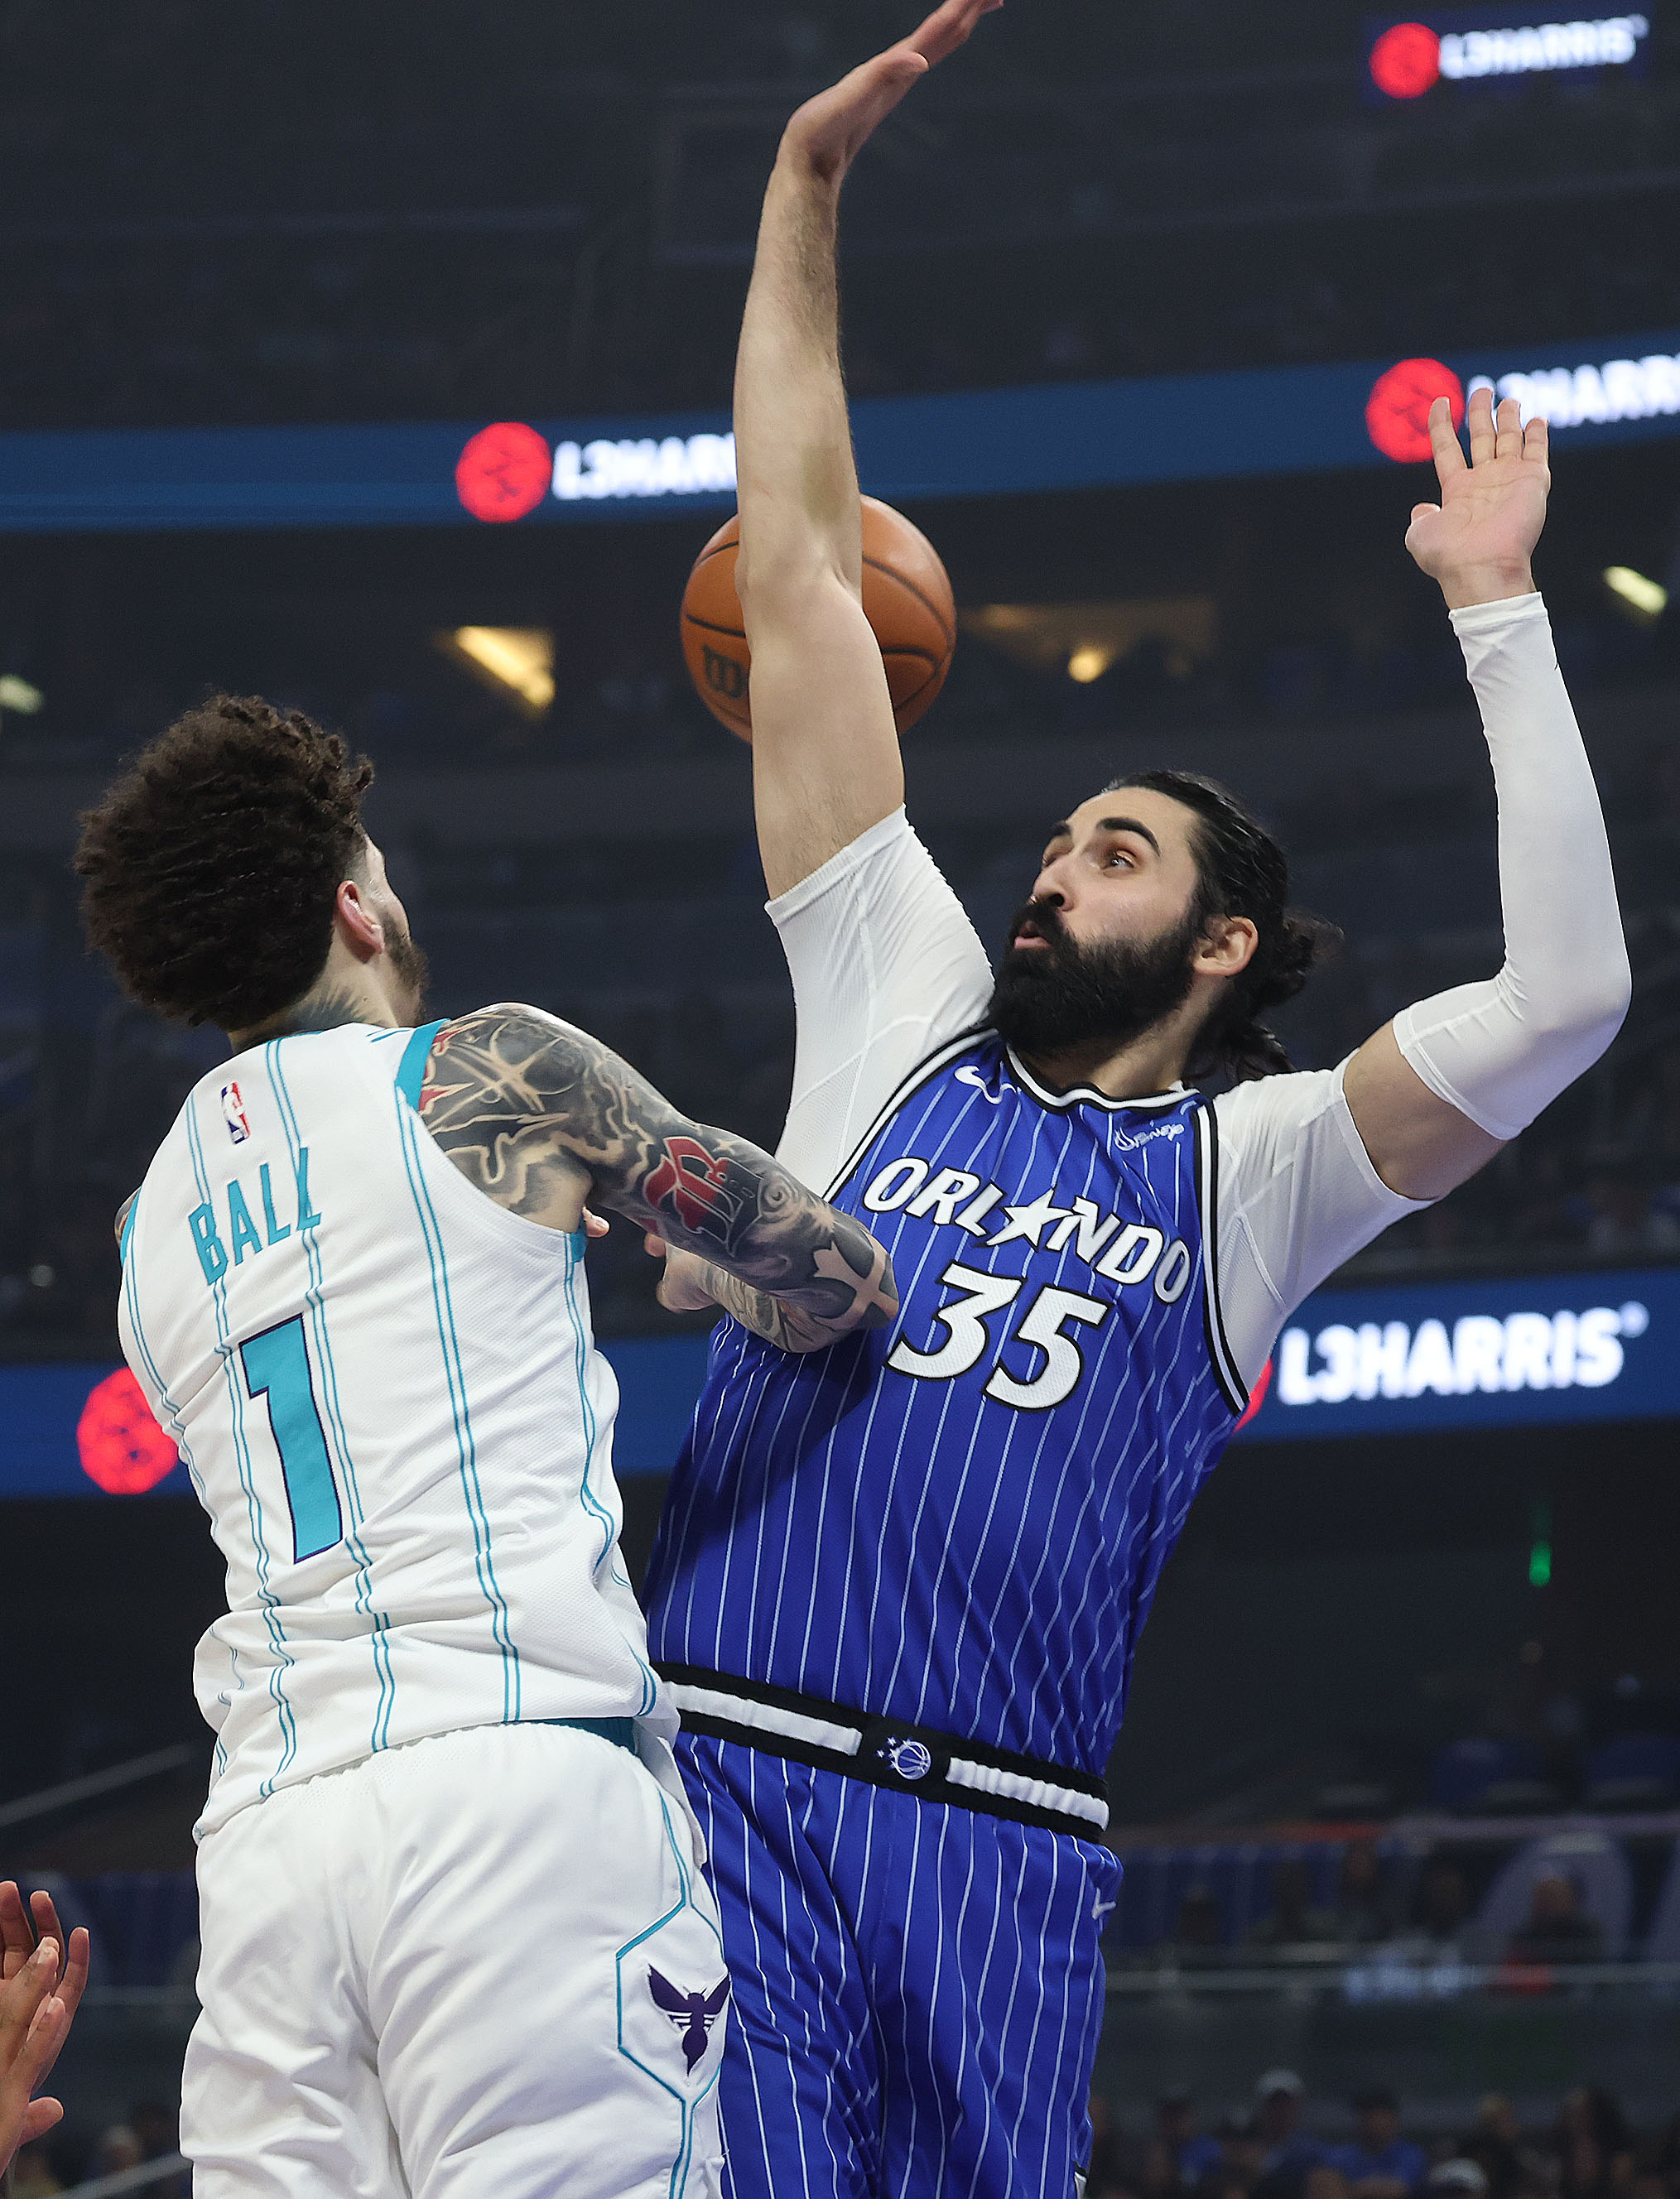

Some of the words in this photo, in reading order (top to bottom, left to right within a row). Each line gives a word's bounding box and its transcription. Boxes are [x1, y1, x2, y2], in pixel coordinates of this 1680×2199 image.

[188, 1146, 322, 1286] BALL
[883, 1258, 1114, 1412] 35
[238, 1312, 344, 1564] 1
